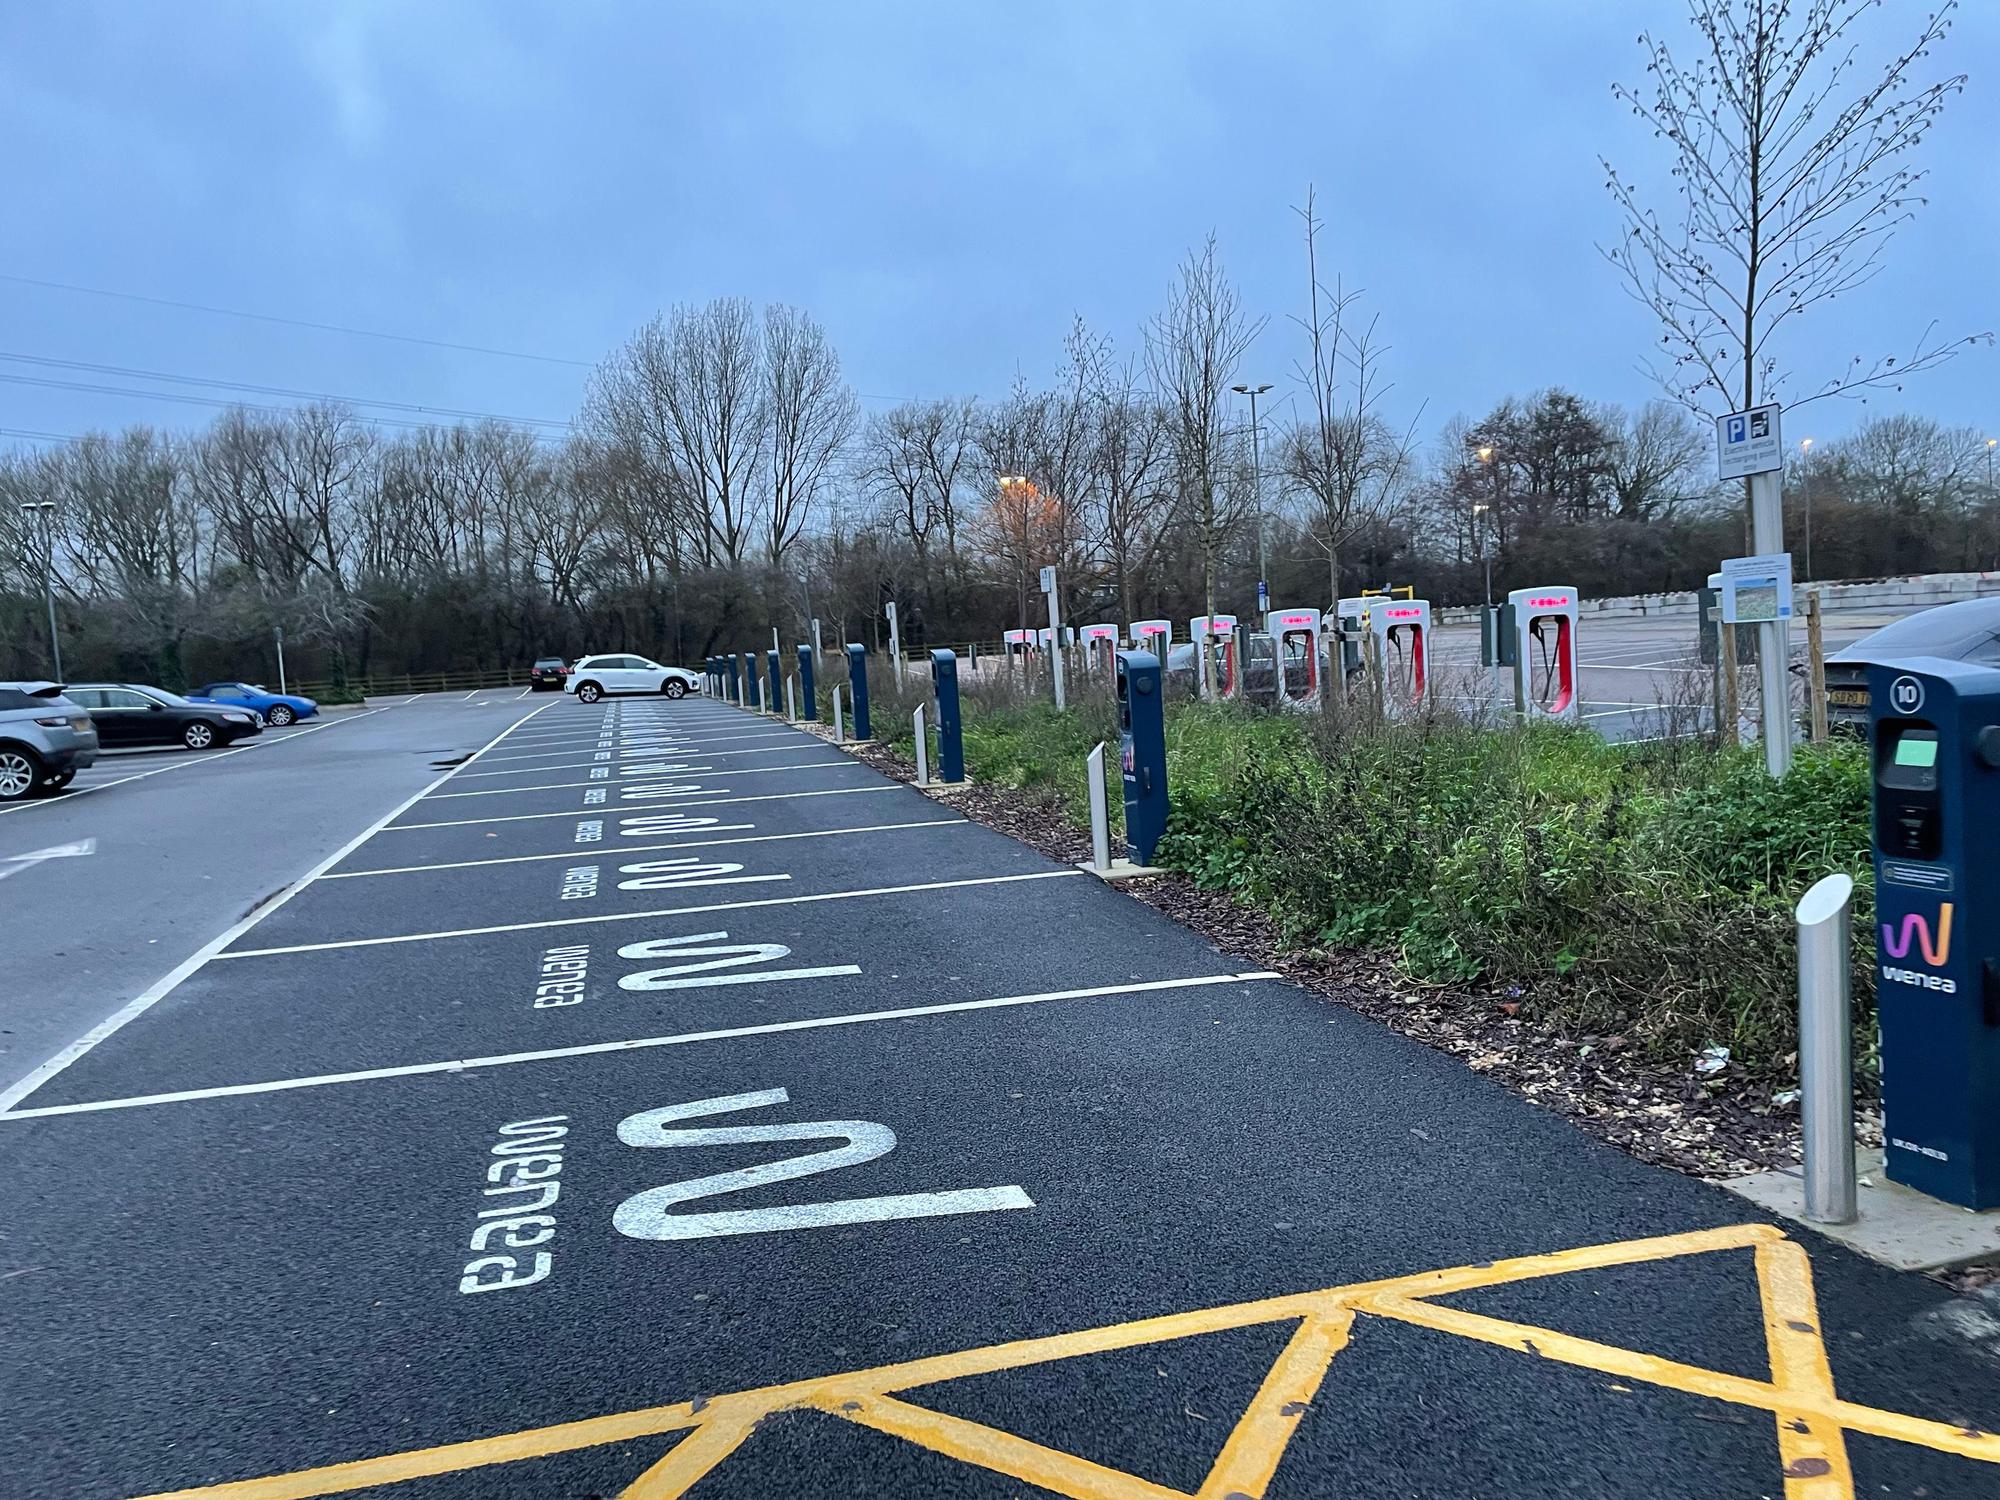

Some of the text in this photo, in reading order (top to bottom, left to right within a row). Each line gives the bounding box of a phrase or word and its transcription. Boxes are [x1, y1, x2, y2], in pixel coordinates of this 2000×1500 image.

[1730, 419, 1743, 442] P
[1897, 685, 1918, 703] 10
[533, 944, 590, 1009] wenea
[1882, 965, 1957, 994] wenea
[459, 1114, 569, 1295] wenea
